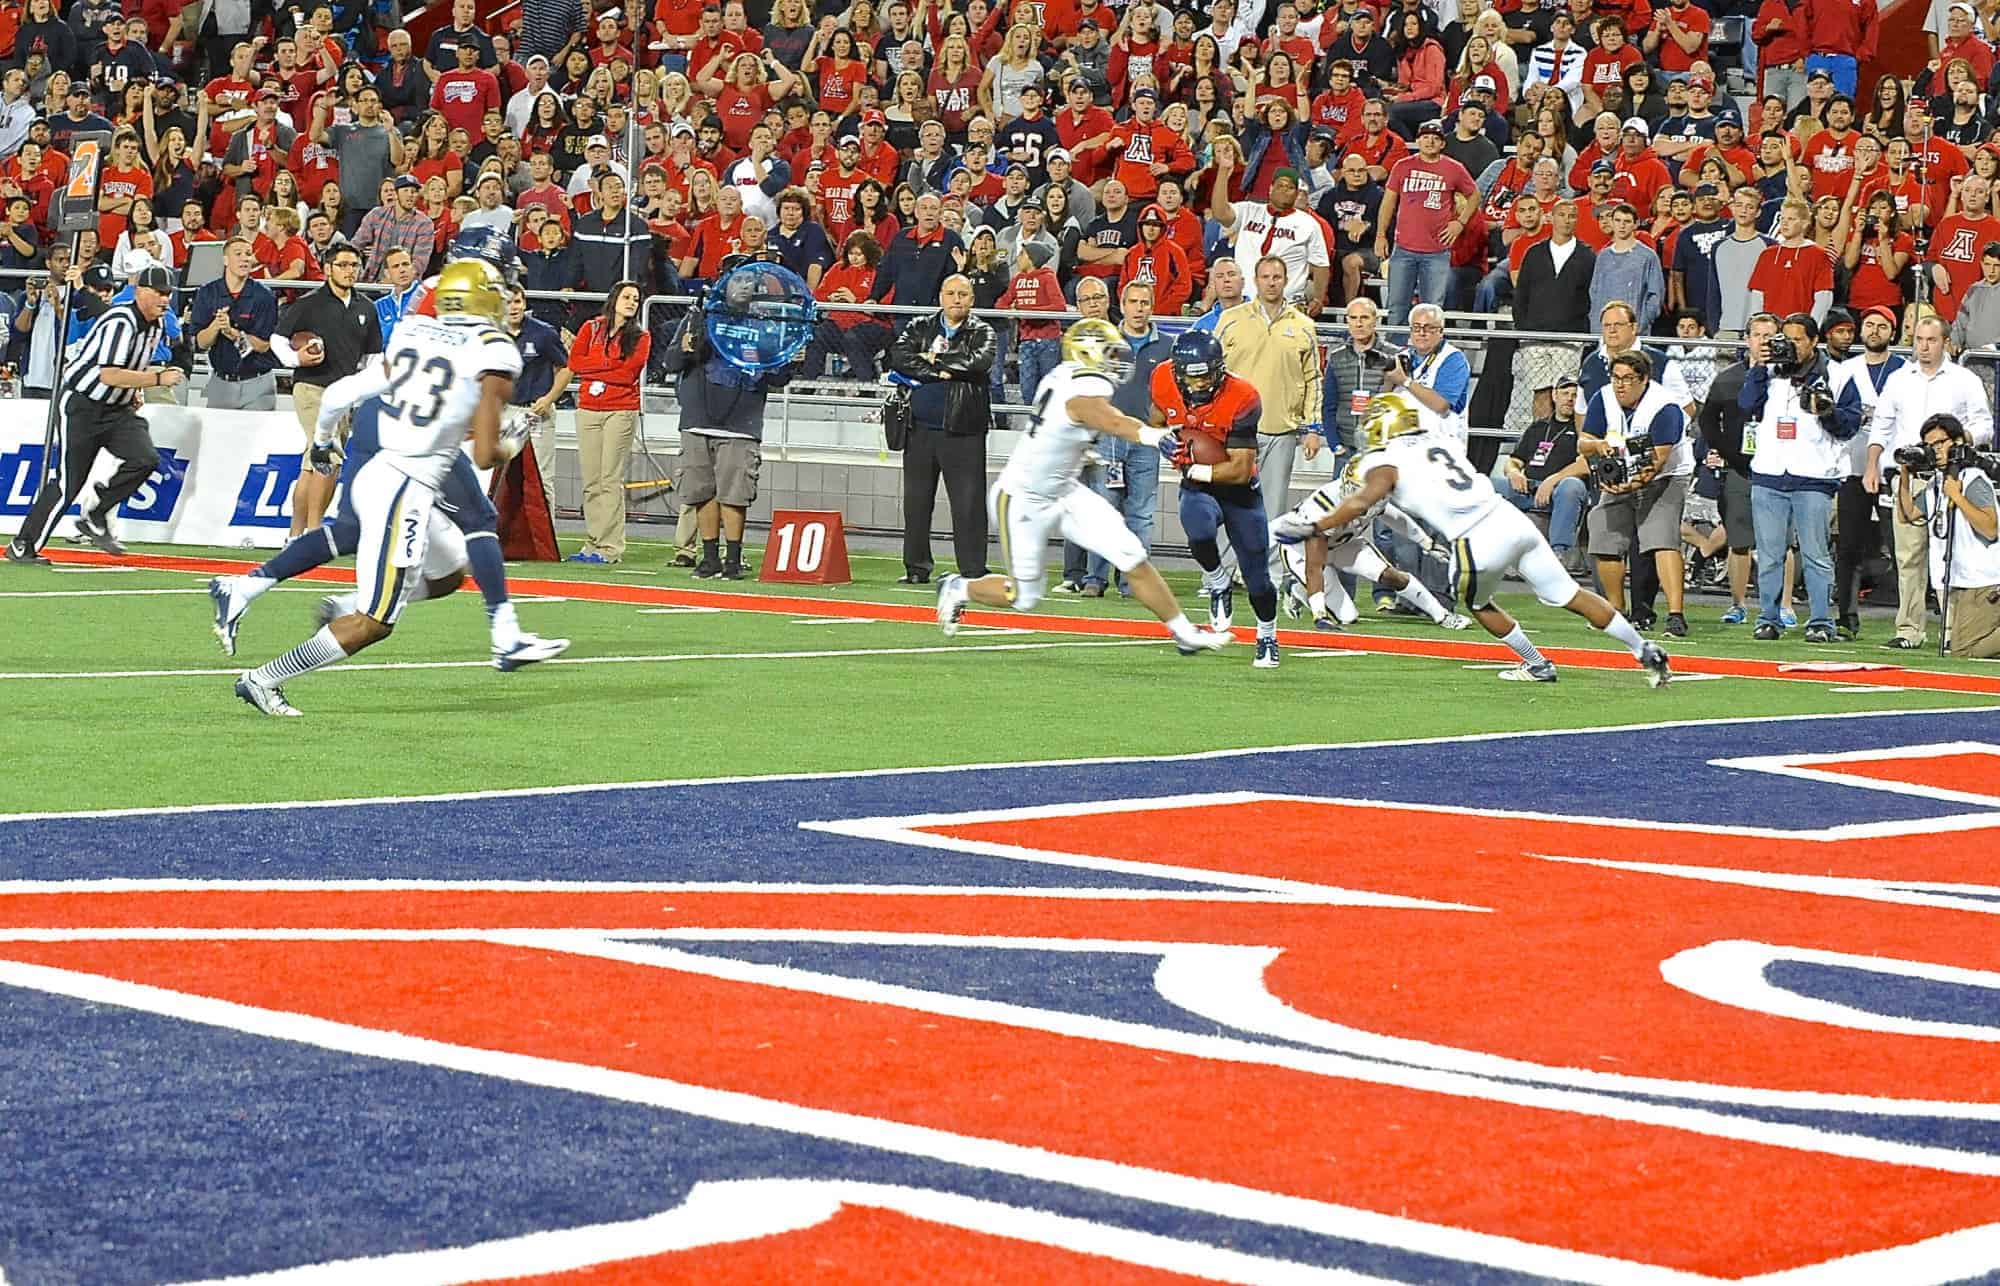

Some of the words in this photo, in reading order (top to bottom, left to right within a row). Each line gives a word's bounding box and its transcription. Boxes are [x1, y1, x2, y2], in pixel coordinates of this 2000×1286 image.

[1124, 133, 1154, 164] A
[67, 140, 98, 197] 2
[1403, 178, 1447, 193] ARIZONA
[1941, 228, 1978, 263] A
[715, 323, 760, 342] ESPN
[379, 348, 454, 427] 23
[1427, 447, 1473, 491] 3
[774, 522, 826, 573] 10
